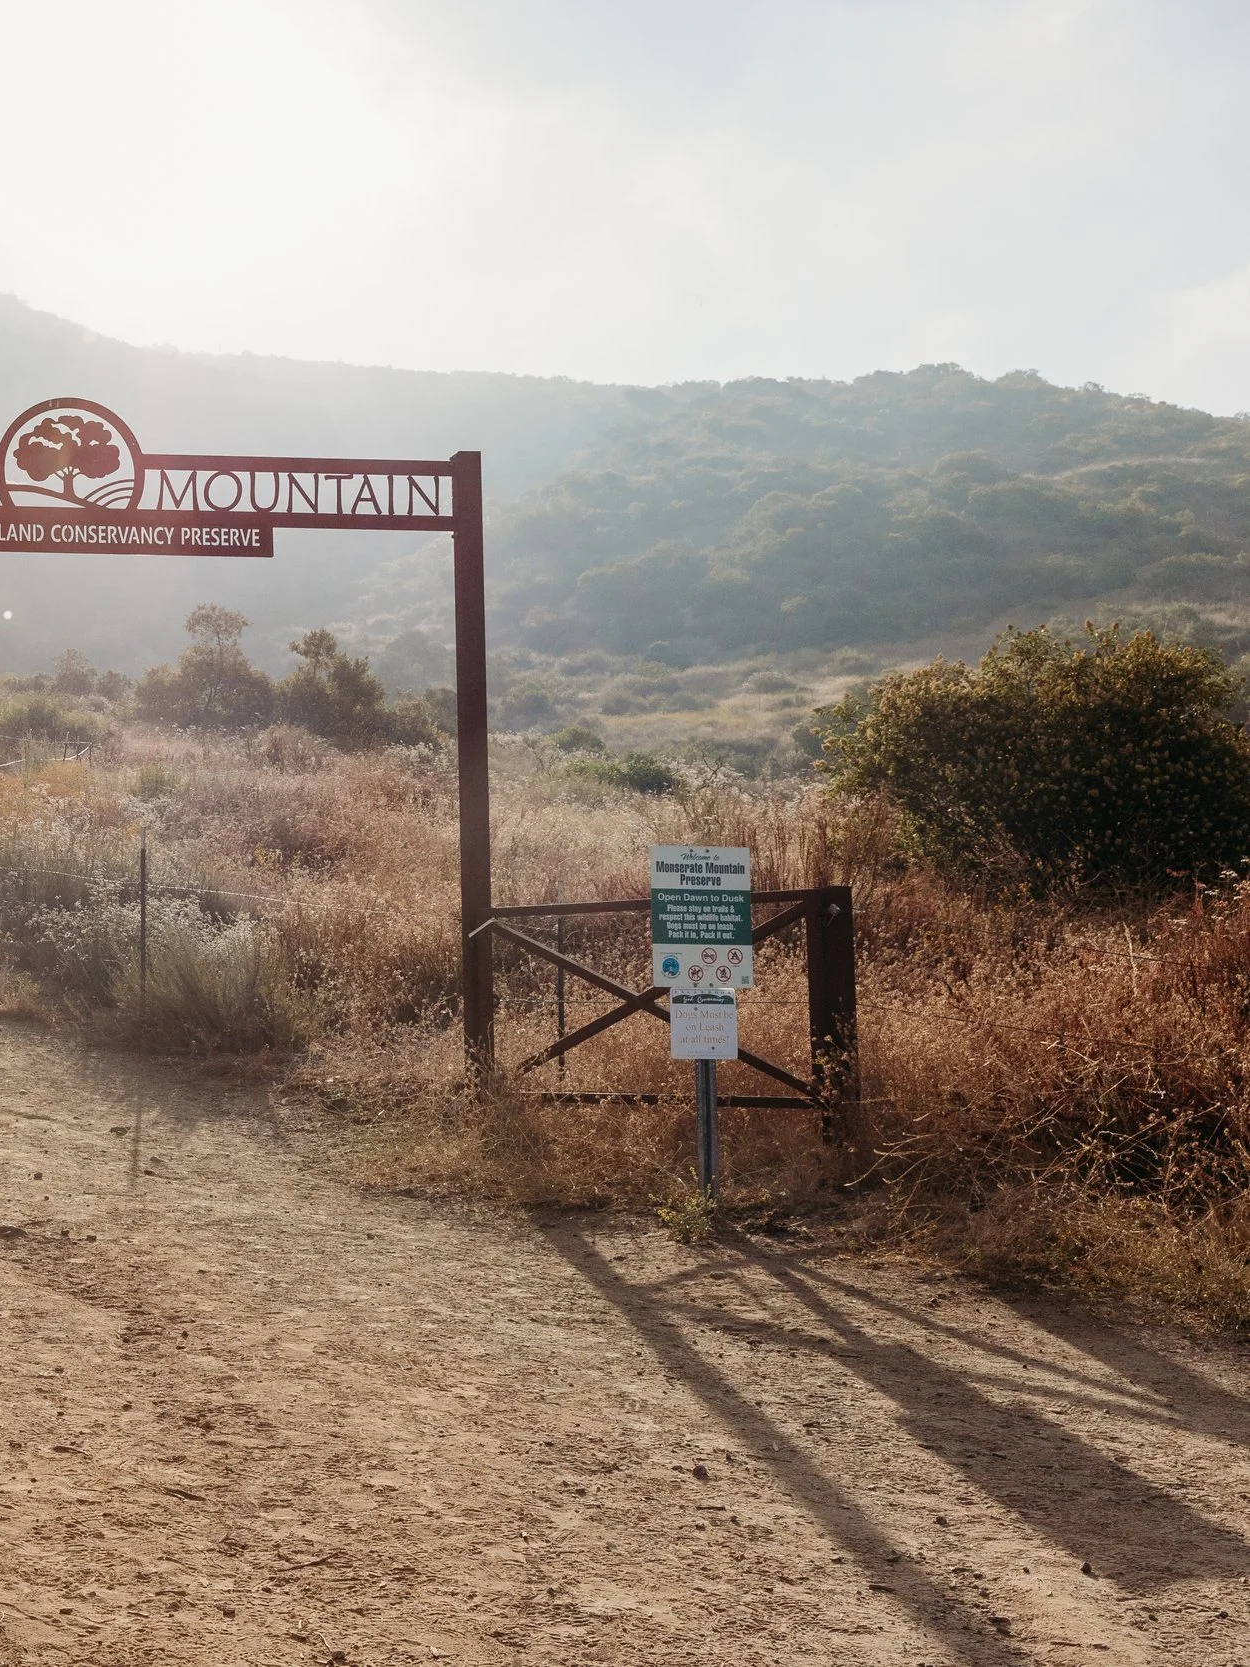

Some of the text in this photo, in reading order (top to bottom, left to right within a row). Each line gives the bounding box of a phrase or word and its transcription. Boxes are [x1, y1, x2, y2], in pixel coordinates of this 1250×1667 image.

[157, 469, 440, 516] MOUNTAIN
[51, 524, 175, 546] CONSERVANCY
[181, 526, 260, 547] PRESERVE
[656, 861, 745, 875] Monserate Mountain
[680, 874, 721, 886] Preserve
[658, 893, 744, 902] Open Dawn to Dusk
[667, 904, 687, 912] Please
[688, 905, 702, 914] stay
[712, 905, 729, 913] trails
[659, 914, 683, 922] respect
[667, 922, 682, 931] Dogs
[699, 922, 707, 930] be
[700, 931, 716, 939] Pack
[675, 1009, 698, 1019] Dogs
[700, 1010, 721, 1019] Must
[699, 1023, 724, 1031] Leash
